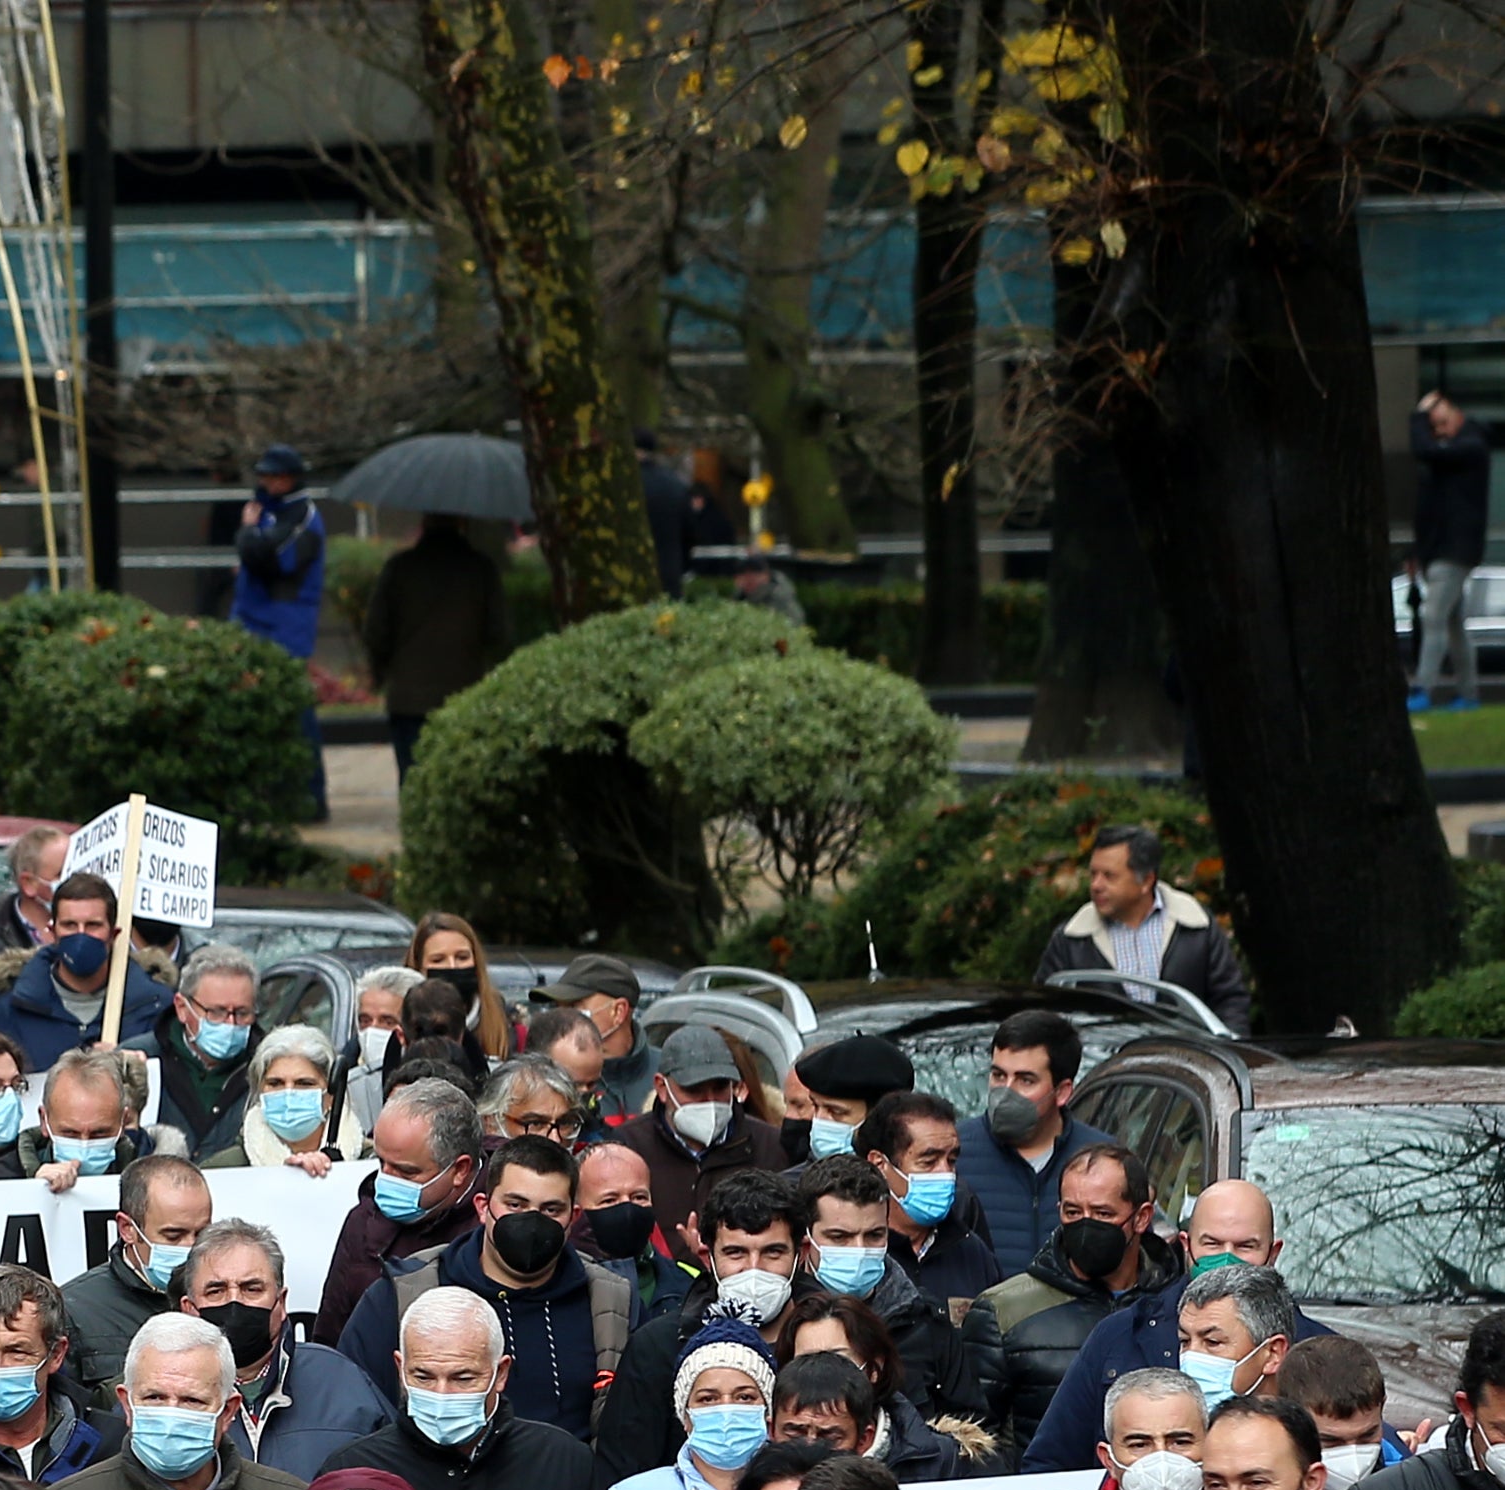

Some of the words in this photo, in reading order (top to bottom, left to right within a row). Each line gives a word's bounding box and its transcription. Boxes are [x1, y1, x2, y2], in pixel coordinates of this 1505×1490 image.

[73, 811, 119, 860] POLITICOS
[143, 812, 186, 848] ORIZOS
[148, 853, 208, 890] SICARIOS
[140, 887, 153, 912] EL
[162, 892, 208, 920] CAMPO
